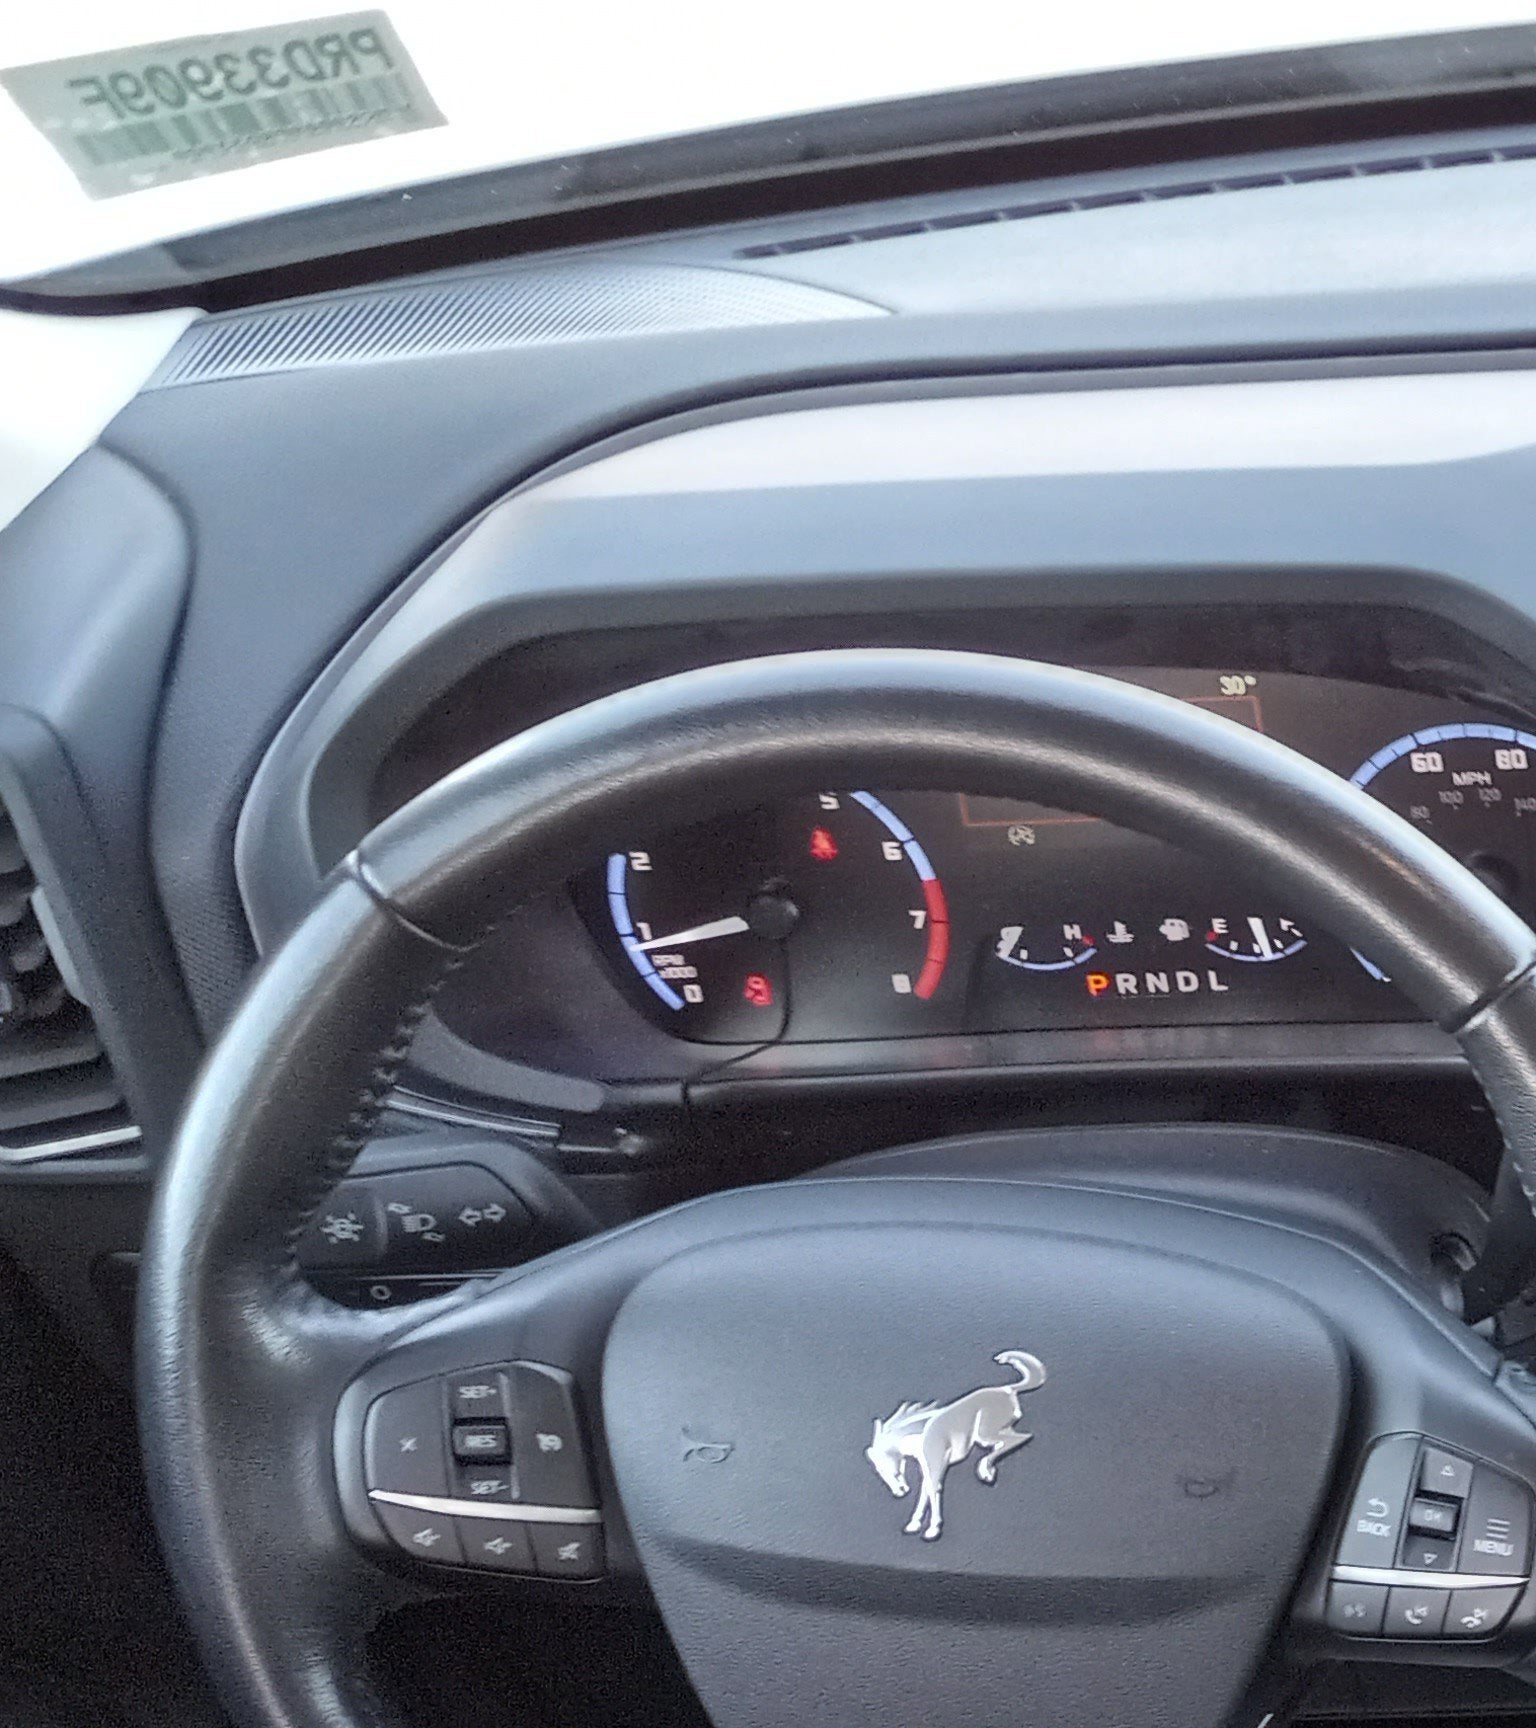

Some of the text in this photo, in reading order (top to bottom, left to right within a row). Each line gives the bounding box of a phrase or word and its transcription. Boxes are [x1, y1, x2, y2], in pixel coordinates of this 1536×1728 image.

[1219, 675, 1257, 696] 30°
[1410, 752, 1445, 773] 60
[1494, 749, 1529, 770] 80
[1452, 771, 1493, 786] MPH
[628, 851, 653, 871] 2
[881, 841, 903, 861] 6
[908, 909, 927, 930] 7
[1211, 917, 1229, 934] E
[636, 921, 653, 941] 1
[1063, 924, 1083, 941] H
[1086, 969, 1229, 997] P R N D L
[1356, 1519, 1392, 1537] BACK
[1472, 1538, 1515, 1557] MENU
